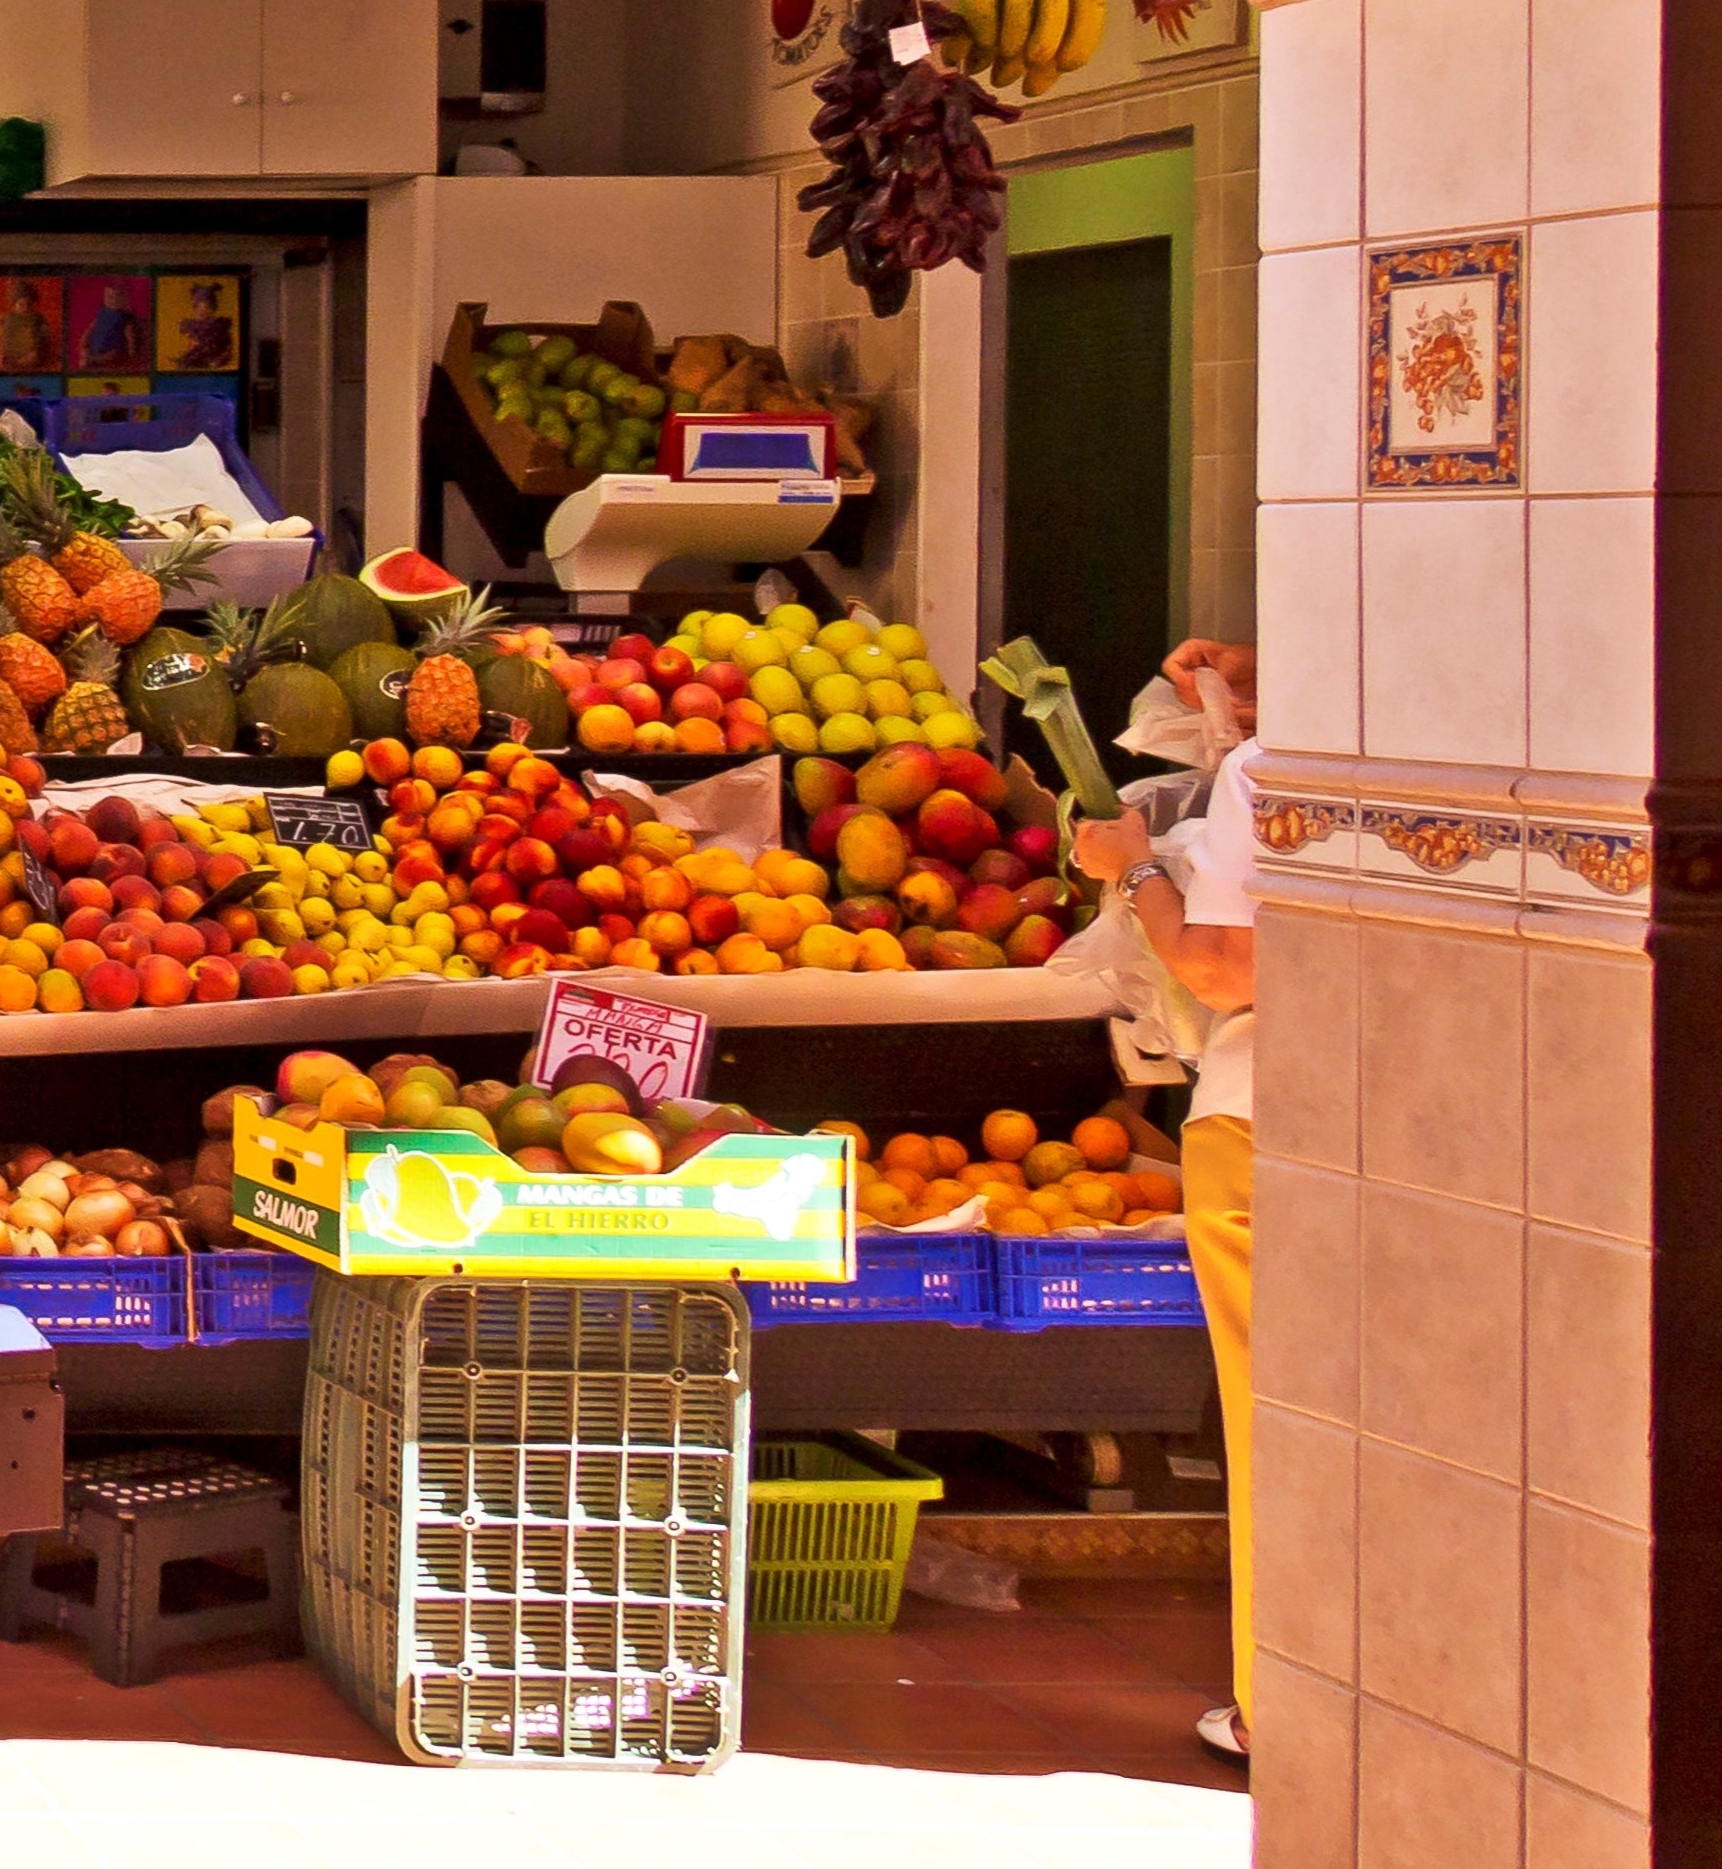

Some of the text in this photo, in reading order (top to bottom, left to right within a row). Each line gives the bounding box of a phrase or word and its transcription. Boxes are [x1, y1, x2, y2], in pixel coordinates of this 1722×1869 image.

[563, 1019, 677, 1060] OFERTA
[516, 1183, 684, 1207] MANGAS DE
[253, 1190, 320, 1240] SALMOR
[529, 1211, 671, 1230] EL HIERRO
